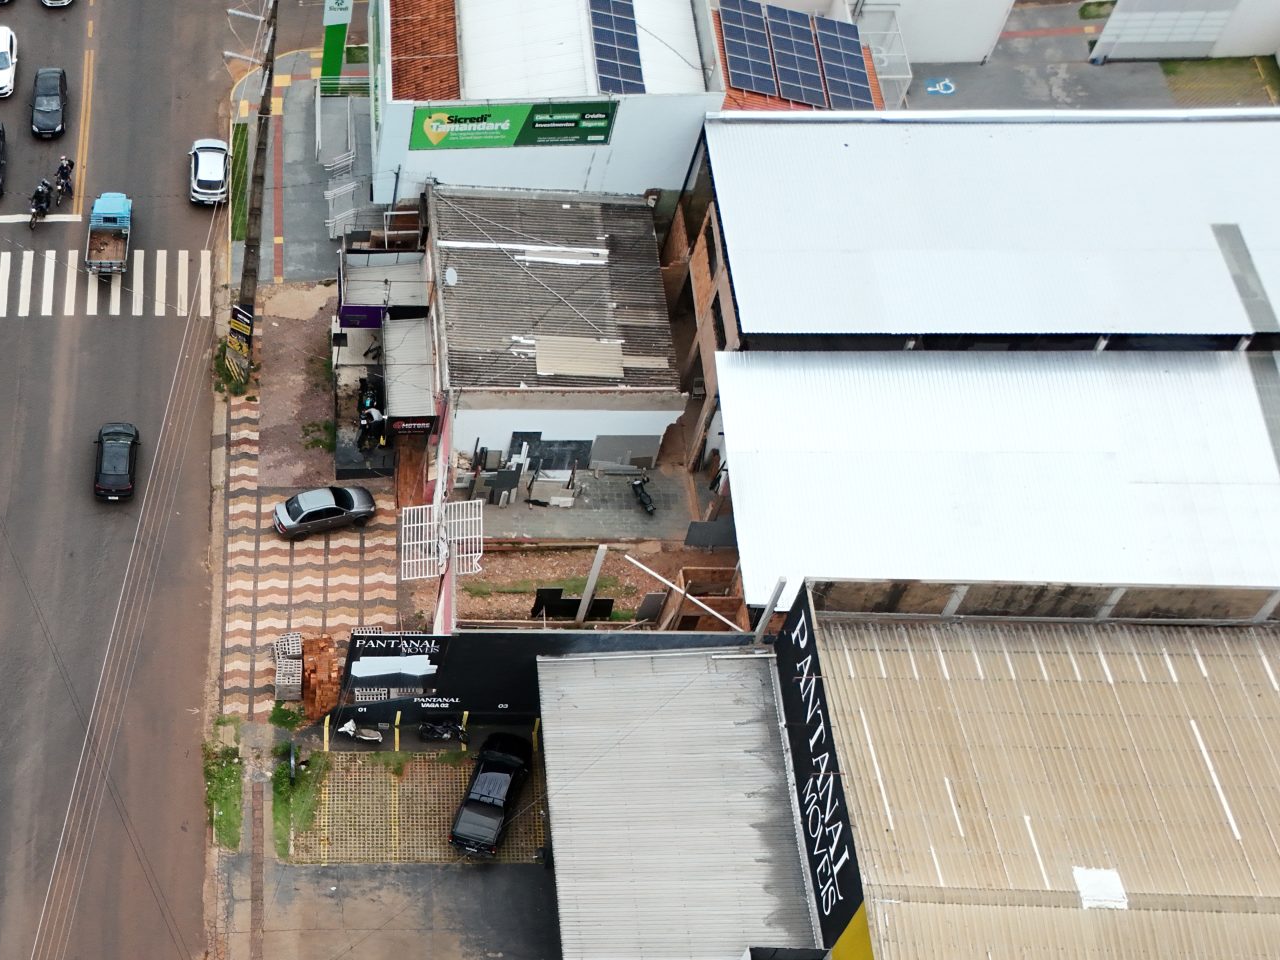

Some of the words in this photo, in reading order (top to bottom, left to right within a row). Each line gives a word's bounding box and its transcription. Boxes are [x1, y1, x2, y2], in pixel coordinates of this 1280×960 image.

[447, 114, 488, 124] Sicredi
[431, 119, 511, 132] Tamandaré
[355, 639, 440, 648] PANTANAL
[790, 609, 850, 900] PANTANAL
